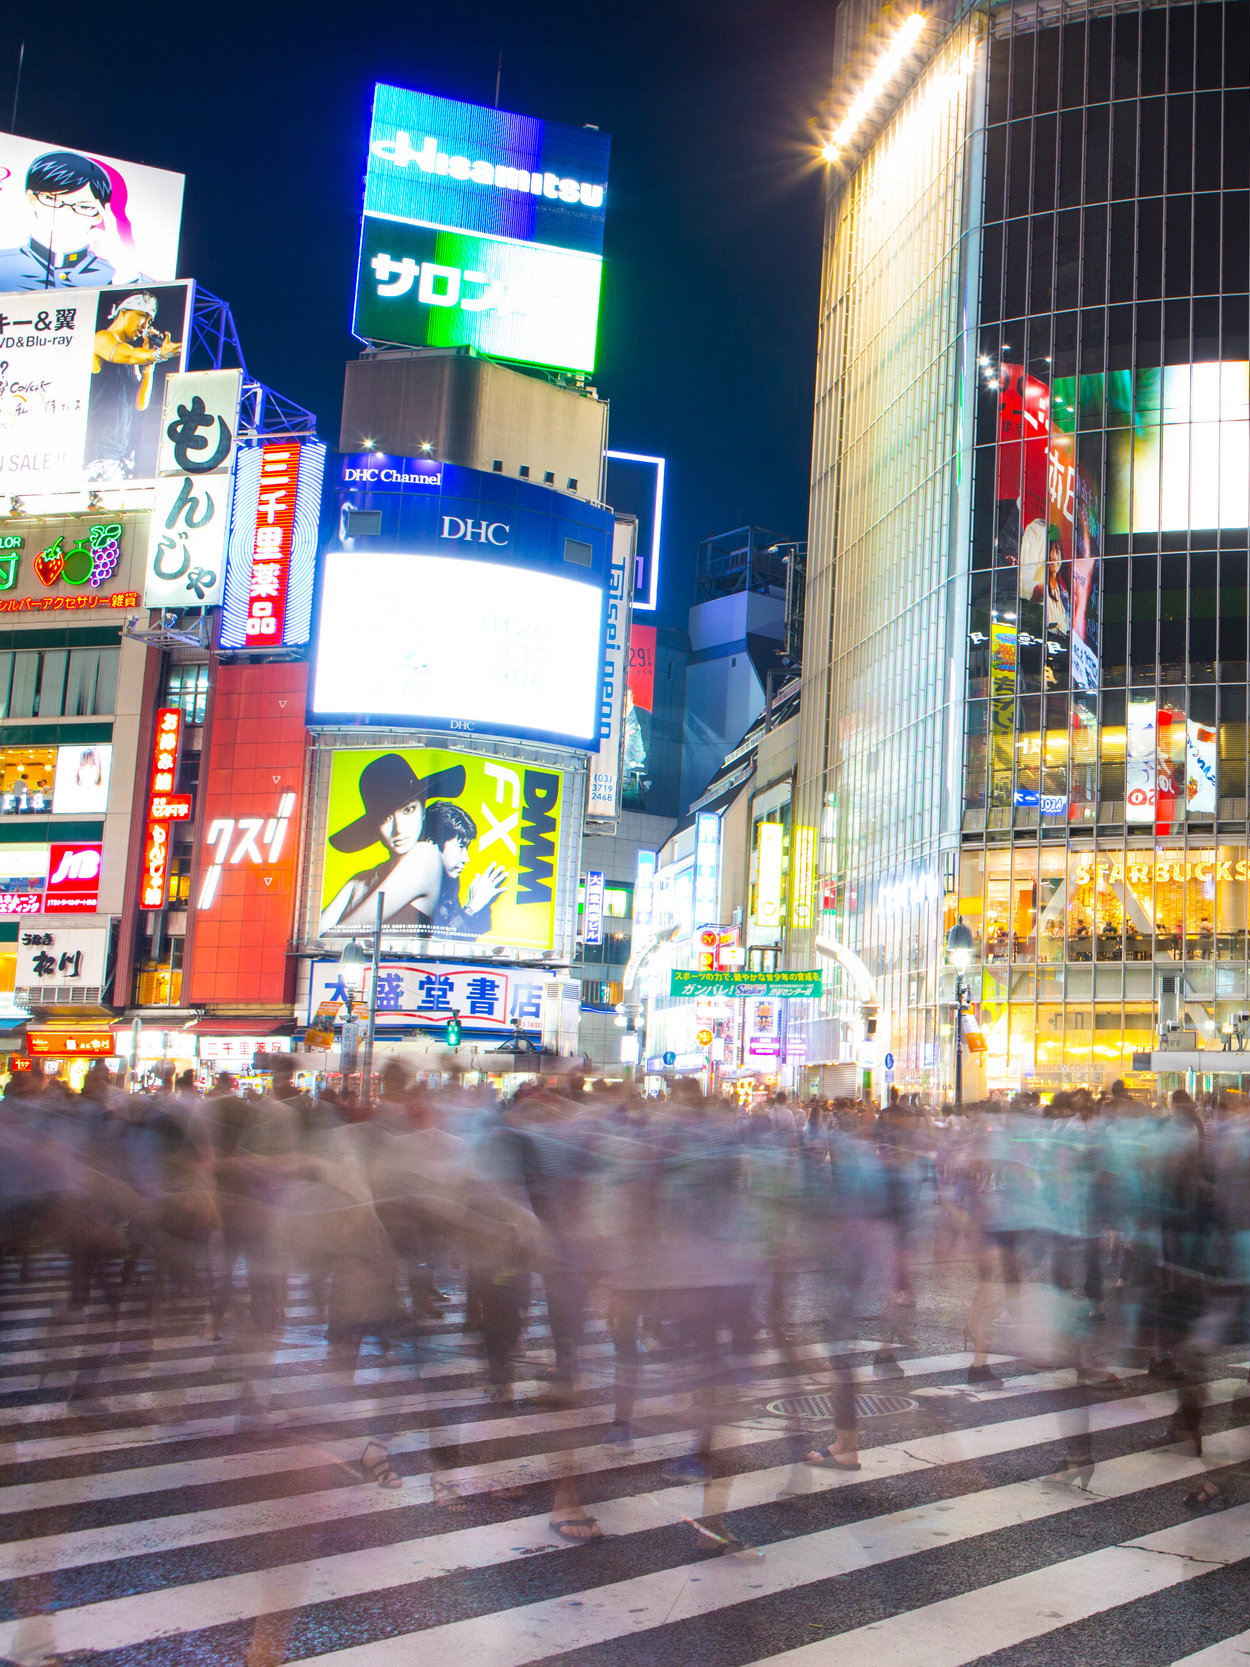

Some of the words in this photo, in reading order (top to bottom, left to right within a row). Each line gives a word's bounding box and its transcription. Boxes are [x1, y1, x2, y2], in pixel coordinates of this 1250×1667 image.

[370, 131, 603, 207] Hisamitsu
[344, 469, 379, 483] DHC
[380, 470, 441, 485] Channel
[154, 396, 233, 599] もんじゃ
[441, 515, 510, 546] DHC
[450, 719, 475, 731] DHC
[592, 783, 613, 793] 3719
[594, 773, 612, 784] (03)
[478, 762, 521, 856] FX
[592, 792, 613, 802] 2468
[516, 769, 560, 905] DMM
[51, 850, 100, 884] JTB
